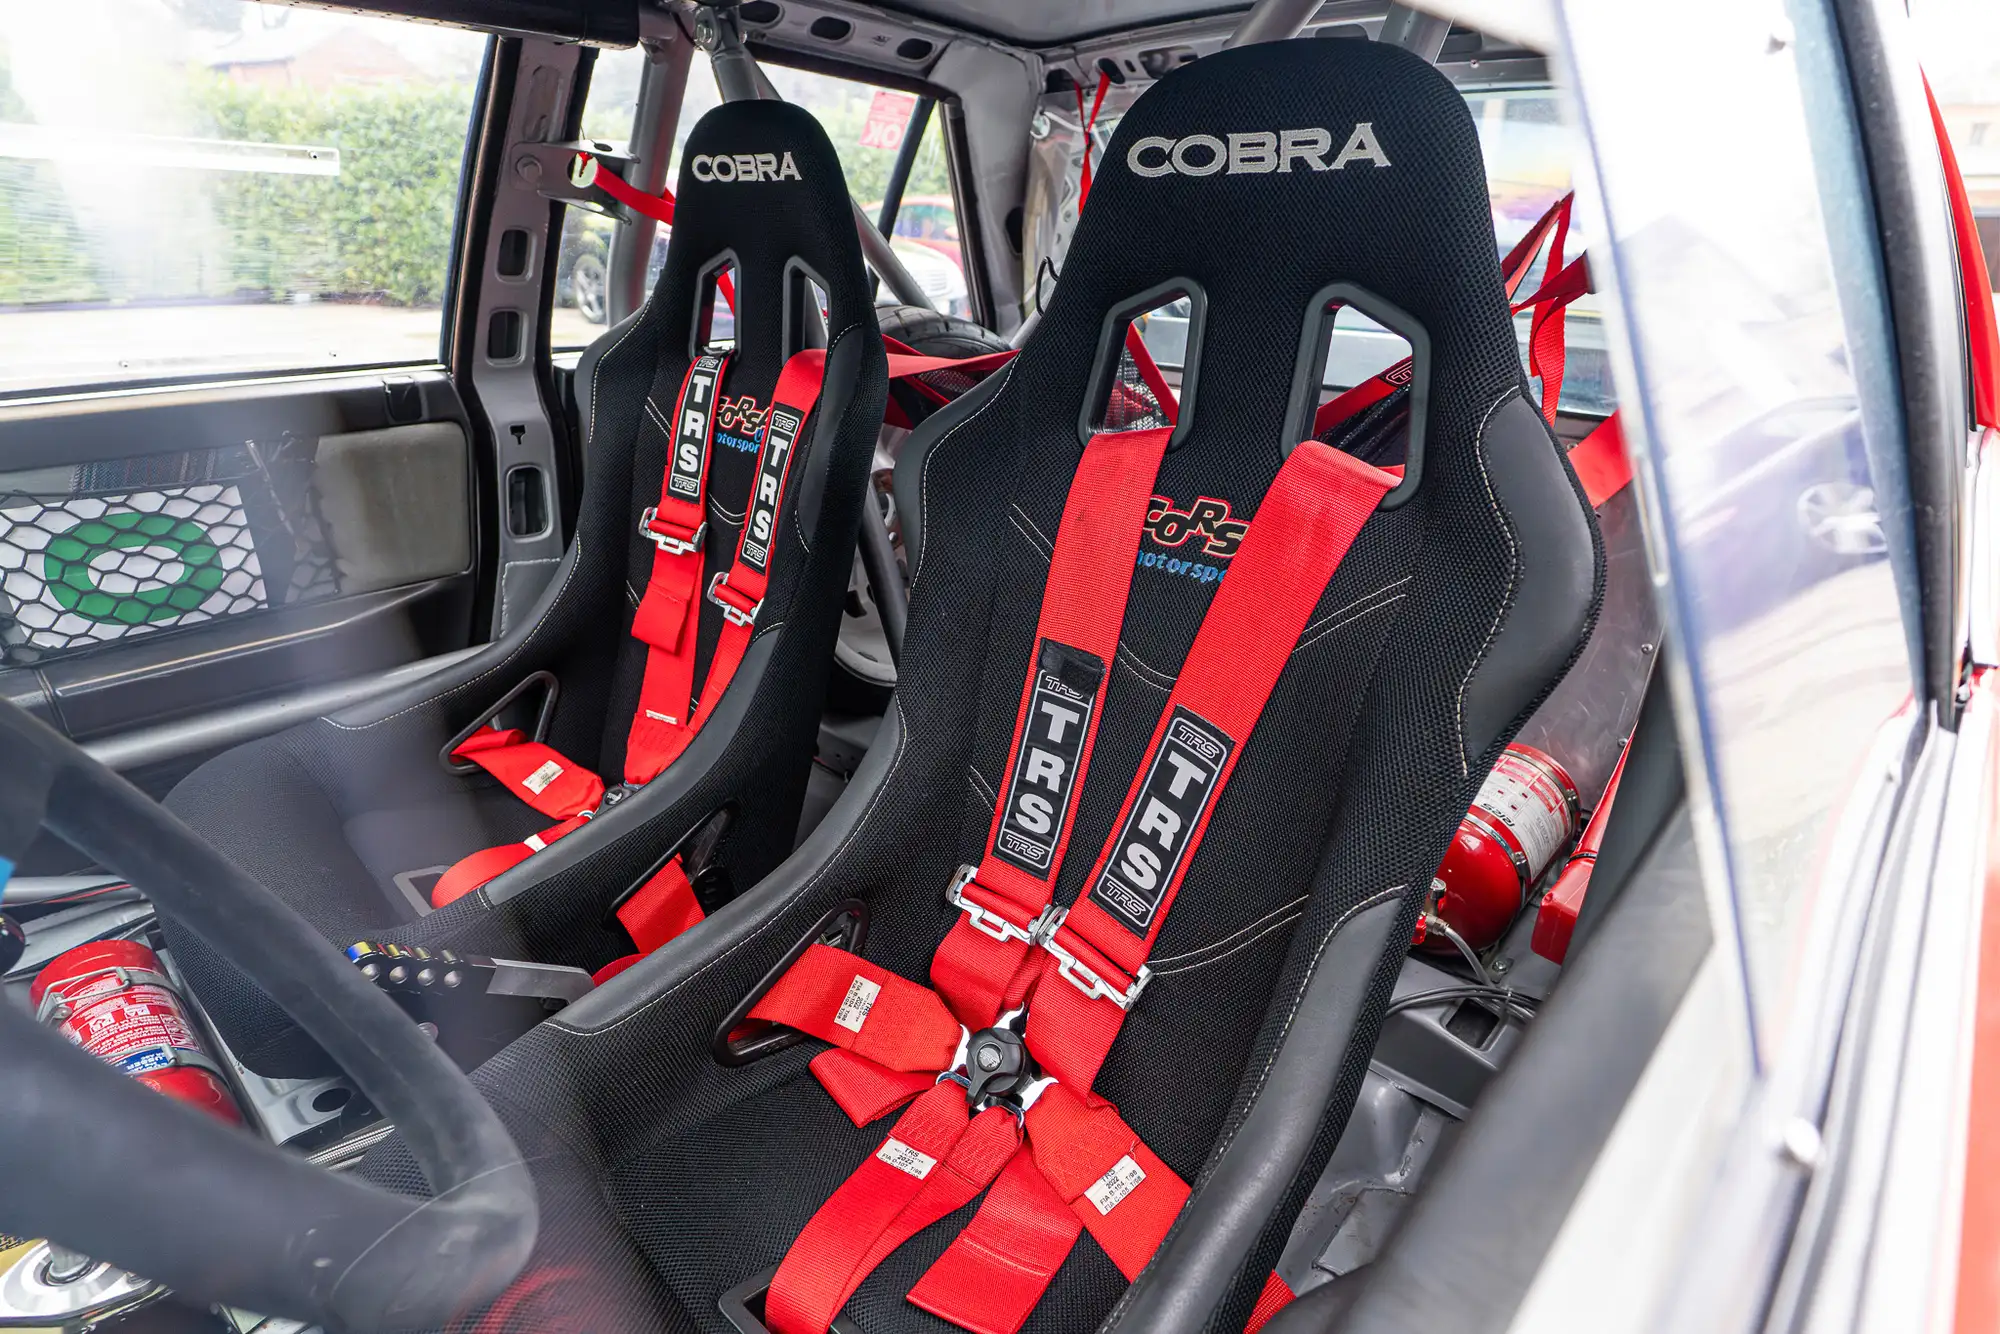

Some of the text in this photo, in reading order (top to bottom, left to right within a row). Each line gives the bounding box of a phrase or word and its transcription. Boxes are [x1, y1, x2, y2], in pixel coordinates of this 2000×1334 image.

[1127, 122, 1392, 177] COBRA
[691, 151, 802, 183] COBRA
[679, 374, 712, 473] TRS
[774, 415, 795, 430] TRS
[674, 478, 697, 492] TRS
[753, 435, 789, 542] TRS
[745, 545, 765, 561] TRS
[1178, 724, 1220, 759] TRS
[1015, 701, 1080, 835] TRS
[1120, 750, 1208, 891] TRS
[1006, 834, 1045, 861] TRS
[1105, 880, 1147, 917] TRS
[882, 1152, 892, 1160] FIA
[897, 1154, 914, 1165] 2022
[905, 1147, 920, 1157] TRS
[1106, 1176, 1120, 1189] 2022
[1099, 1195, 1110, 1205] FIA
[1104, 1201, 1115, 1211] FIA
